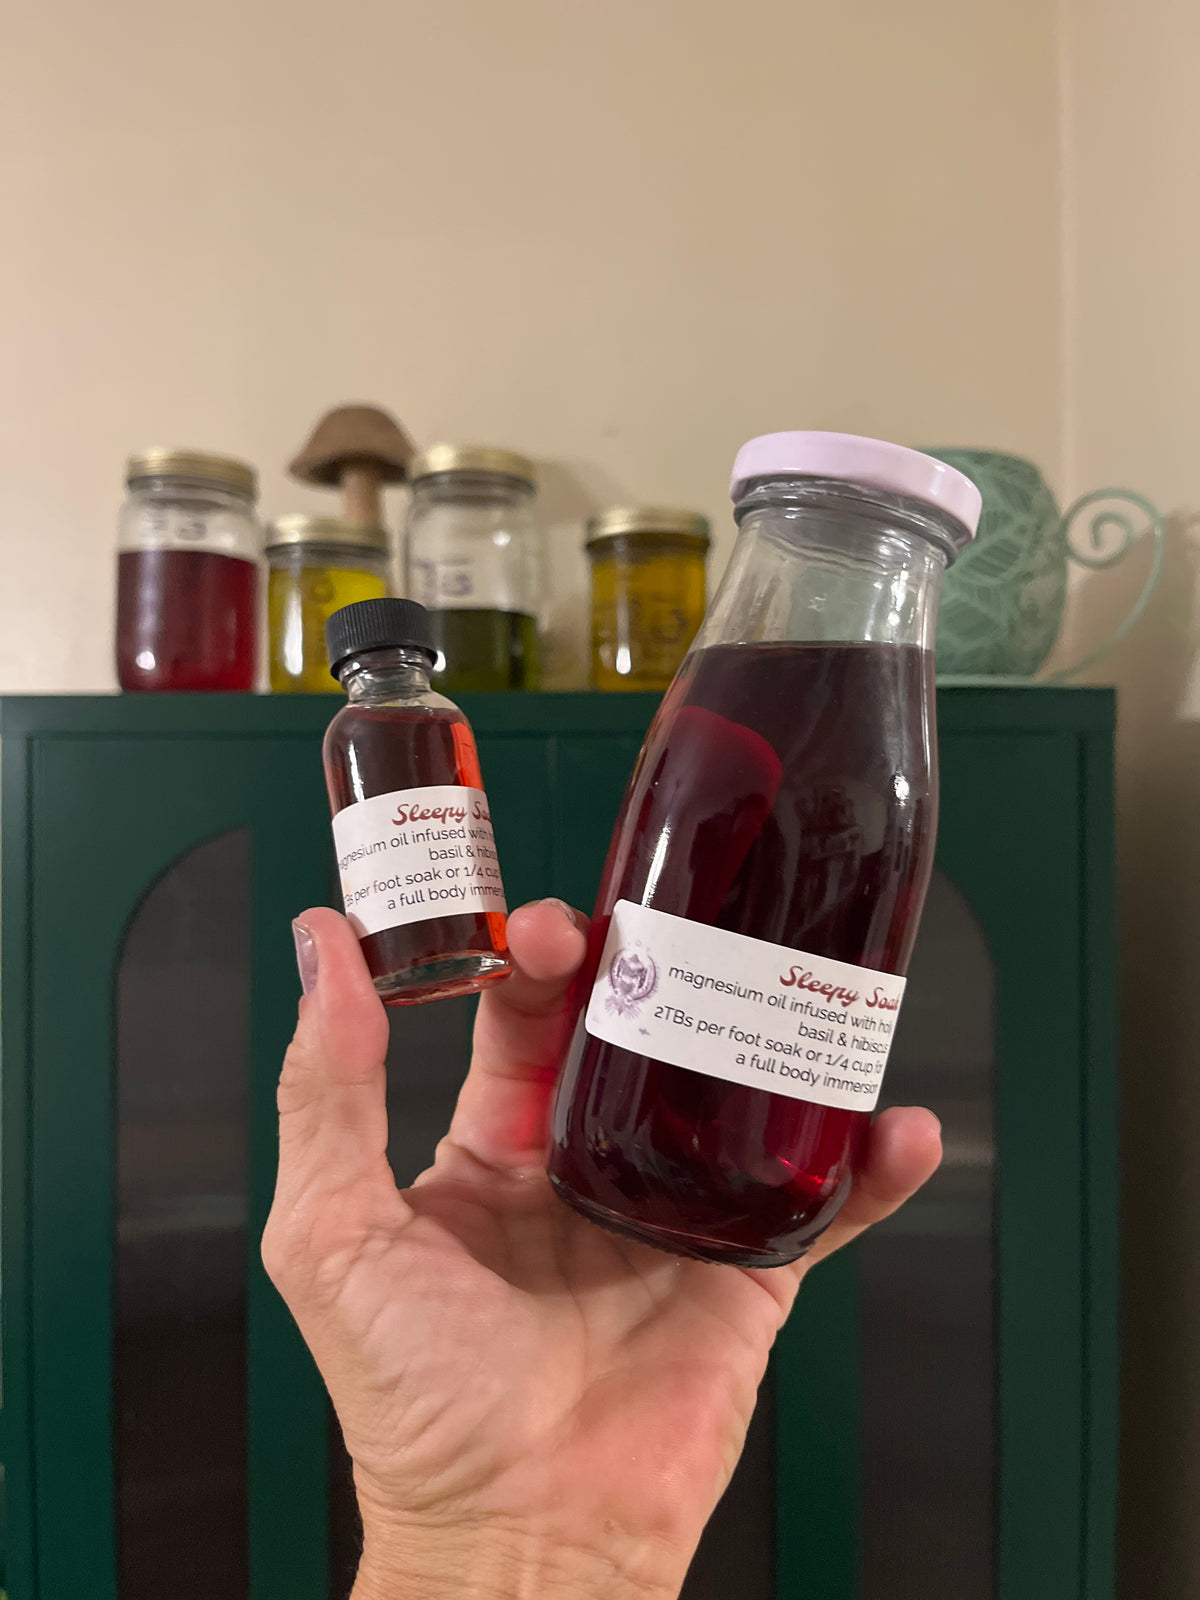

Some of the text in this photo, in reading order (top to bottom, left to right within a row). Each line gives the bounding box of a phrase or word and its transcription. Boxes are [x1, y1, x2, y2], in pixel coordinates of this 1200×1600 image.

[392, 803, 467, 825] Sleepy
[391, 833, 408, 848] oil
[413, 827, 466, 843] infused
[429, 846, 463, 861] basil
[466, 845, 474, 857] &
[355, 886, 371, 901] per
[374, 876, 401, 892] foot
[406, 868, 442, 885] soak
[446, 867, 460, 879] or
[464, 864, 483, 877] 1/4
[486, 867, 499, 879] cup
[387, 899, 396, 910] a
[400, 890, 424, 906] full
[429, 883, 466, 901] body
[668, 965, 763, 1003] magnesium
[767, 992, 787, 1010] oil
[790, 997, 847, 1025] infused
[851, 1014, 877, 1032] with
[779, 966, 860, 1007] Sleepy
[654, 1006, 693, 1028] 2TBs
[697, 1020, 726, 1039] per
[729, 1026, 761, 1046] foot
[764, 1036, 802, 1057] soak
[806, 1047, 822, 1061] or
[825, 1053, 849, 1070] 1/4
[852, 1059, 873, 1076] cup
[797, 1022, 834, 1045] basil
[837, 1032, 848, 1046] &
[735, 1053, 745, 1065] a
[749, 1053, 777, 1073] full
[780, 1061, 821, 1087] body
